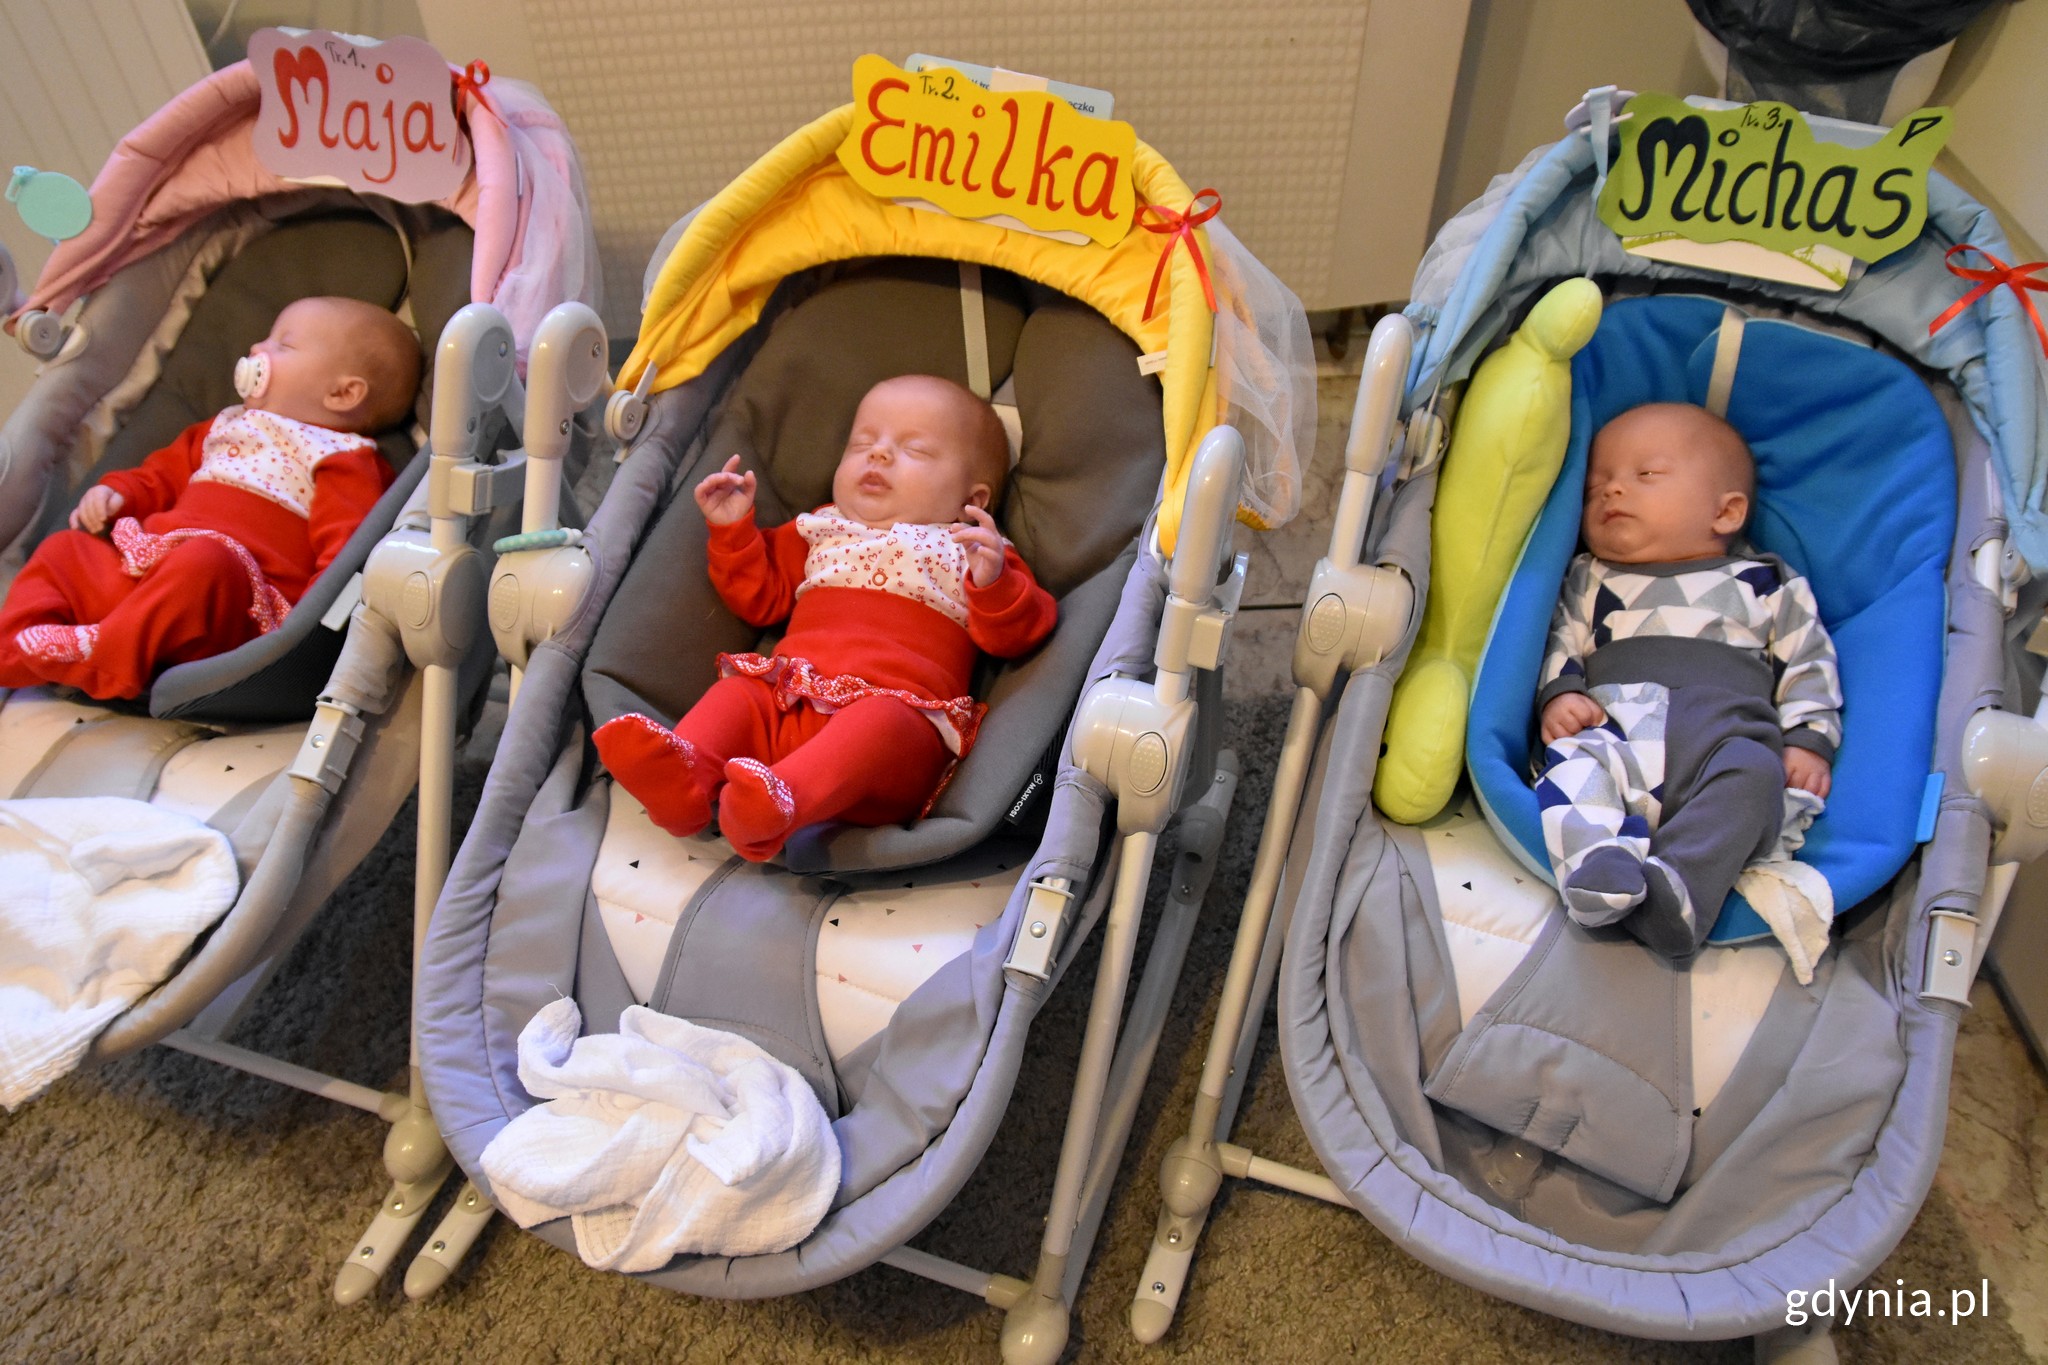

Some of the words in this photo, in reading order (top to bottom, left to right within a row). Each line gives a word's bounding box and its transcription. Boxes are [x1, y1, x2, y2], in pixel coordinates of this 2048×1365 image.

[273, 45, 446, 183] Maja
[860, 77, 1119, 220] Emilka
[1619, 114, 1944, 239] Michaś
[1009, 782, 1037, 818] MAXI-COSI
